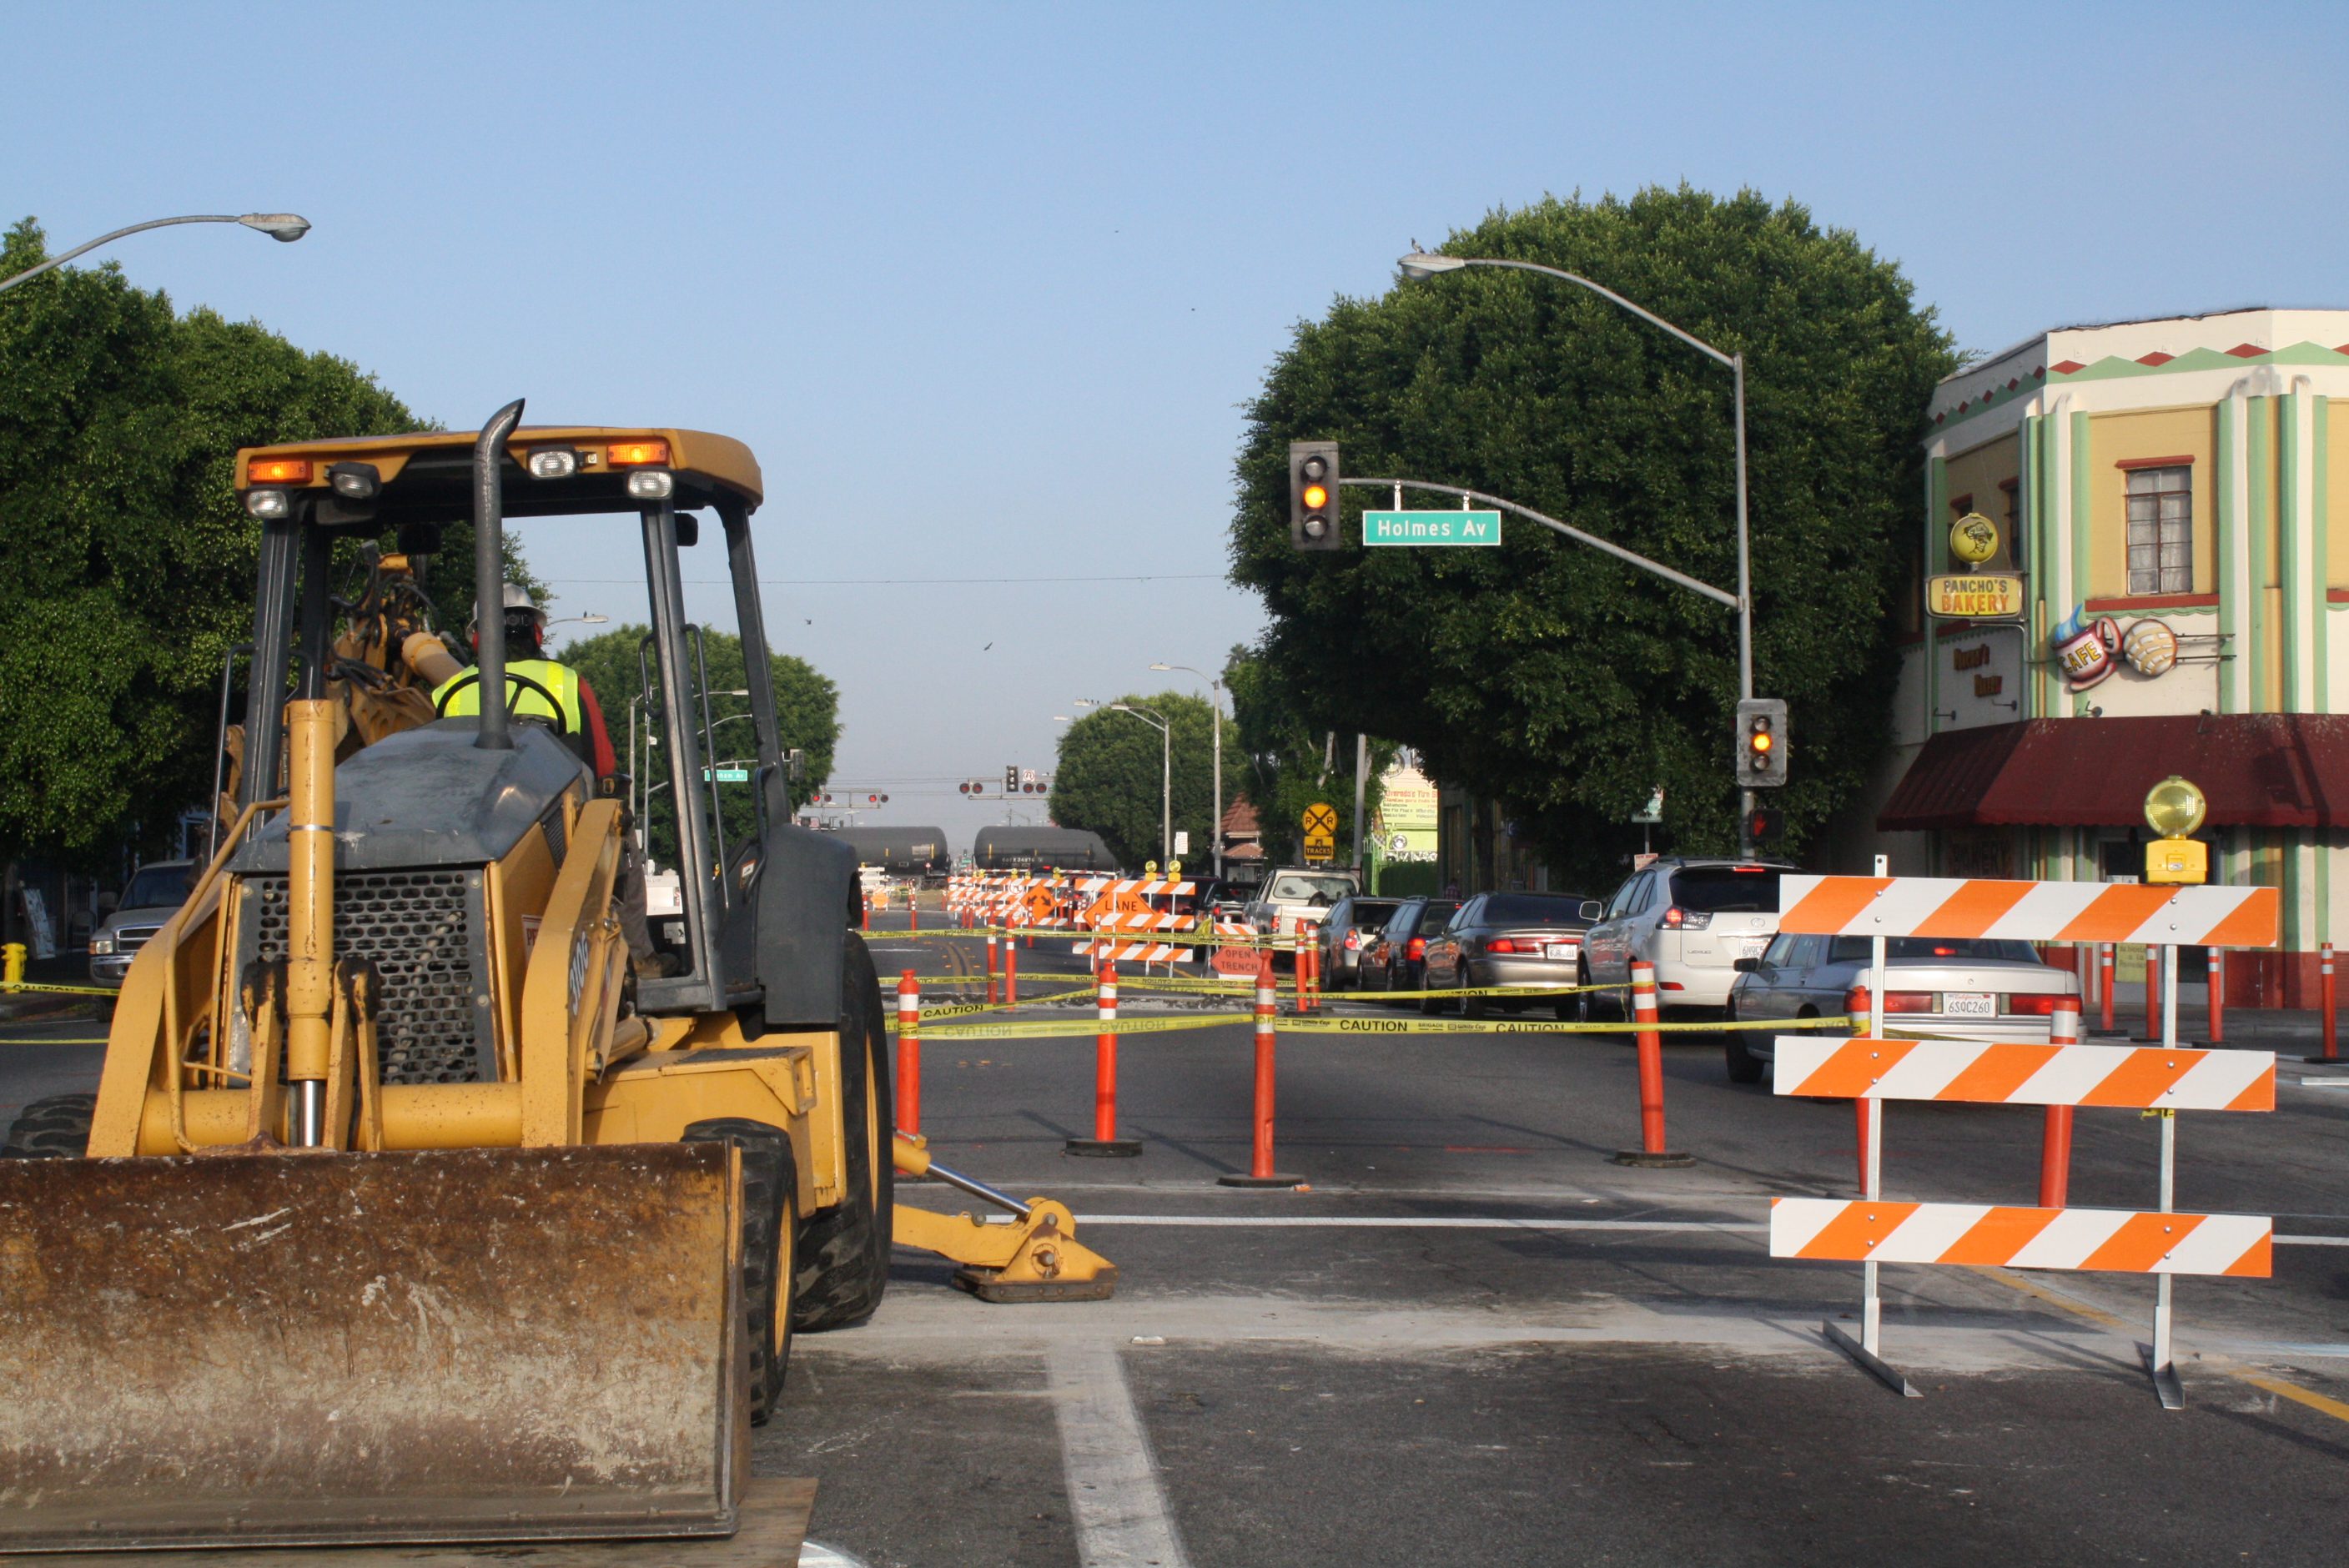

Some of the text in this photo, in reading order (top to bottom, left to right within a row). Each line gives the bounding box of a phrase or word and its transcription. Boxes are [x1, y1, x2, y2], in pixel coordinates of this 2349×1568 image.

[1378, 520, 1486, 536] Holmes Av
[1944, 580, 2007, 593] PANCHO'S
[1941, 594, 2009, 612] BAKERY
[2057, 641, 2101, 673] CAFE
[1105, 901, 1137, 912] LANE
[1225, 950, 1251, 958] OPEN
[1221, 961, 1258, 972] TRENCH
[923, 1004, 983, 1018] CAUTION
[1949, 1001, 1990, 1013] 6SQC260
[1340, 1019, 1407, 1032] CAUTION
[1496, 1023, 1564, 1033] CAUTION
